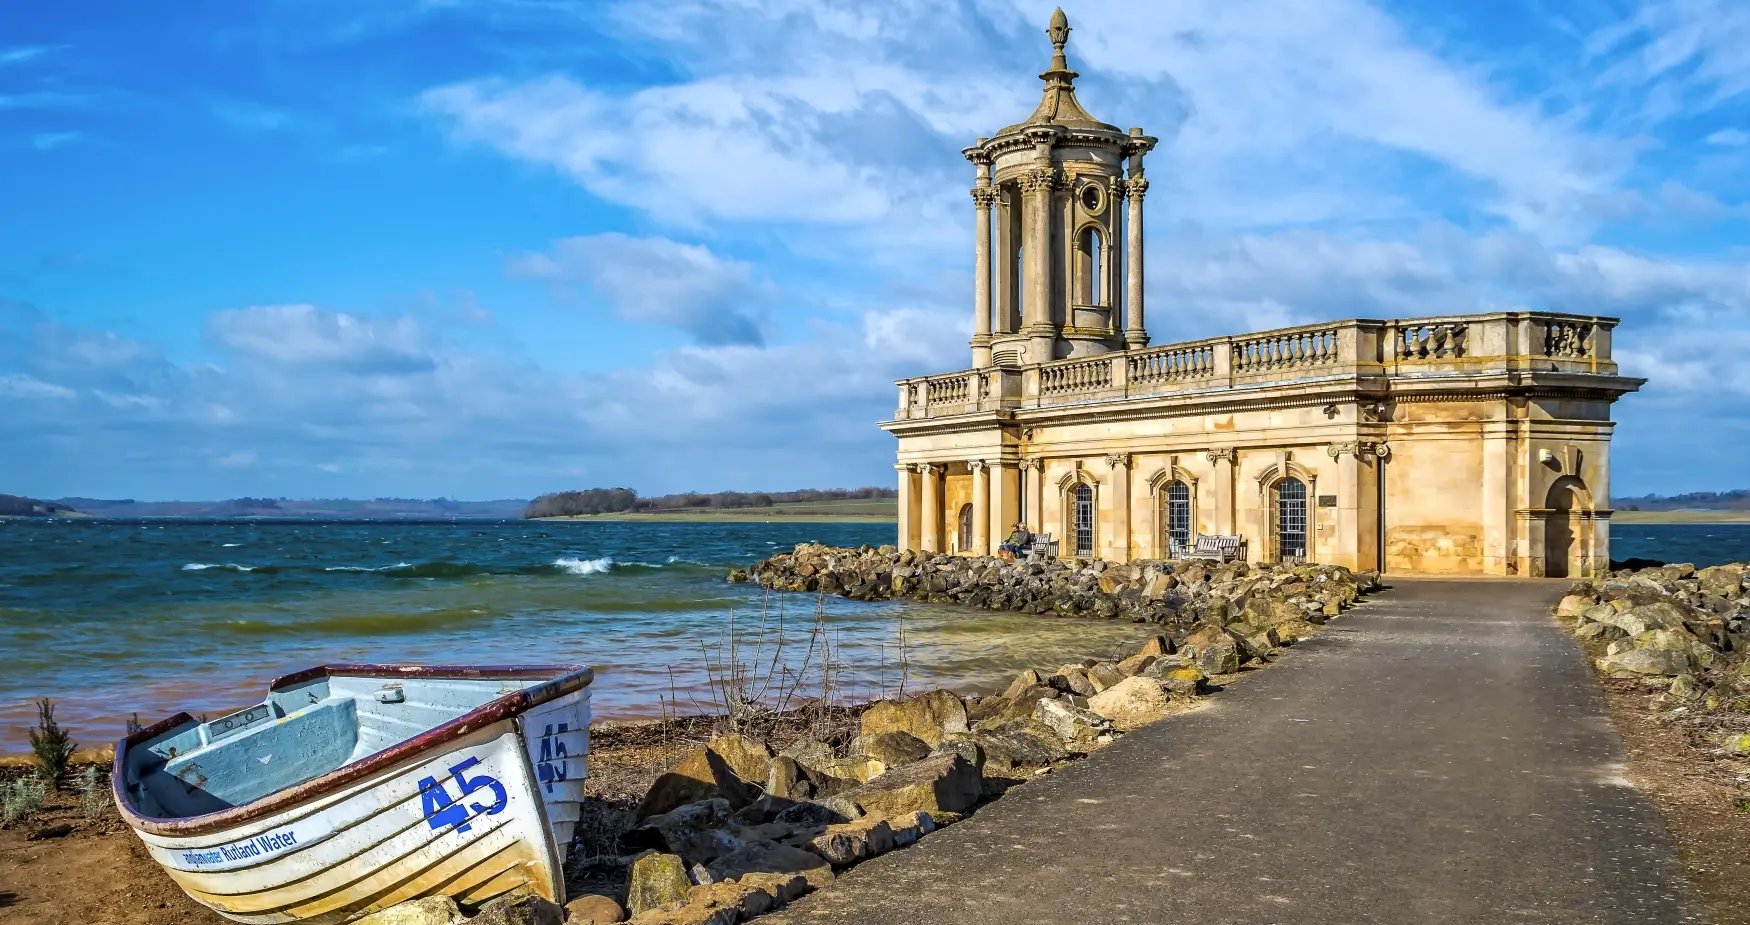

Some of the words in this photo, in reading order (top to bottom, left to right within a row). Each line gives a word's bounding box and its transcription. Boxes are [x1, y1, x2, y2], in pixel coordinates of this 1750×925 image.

[537, 723, 569, 794] 45
[418, 756, 507, 833] 45
[220, 839, 262, 861] Rutland
[256, 830, 297, 853] Water
